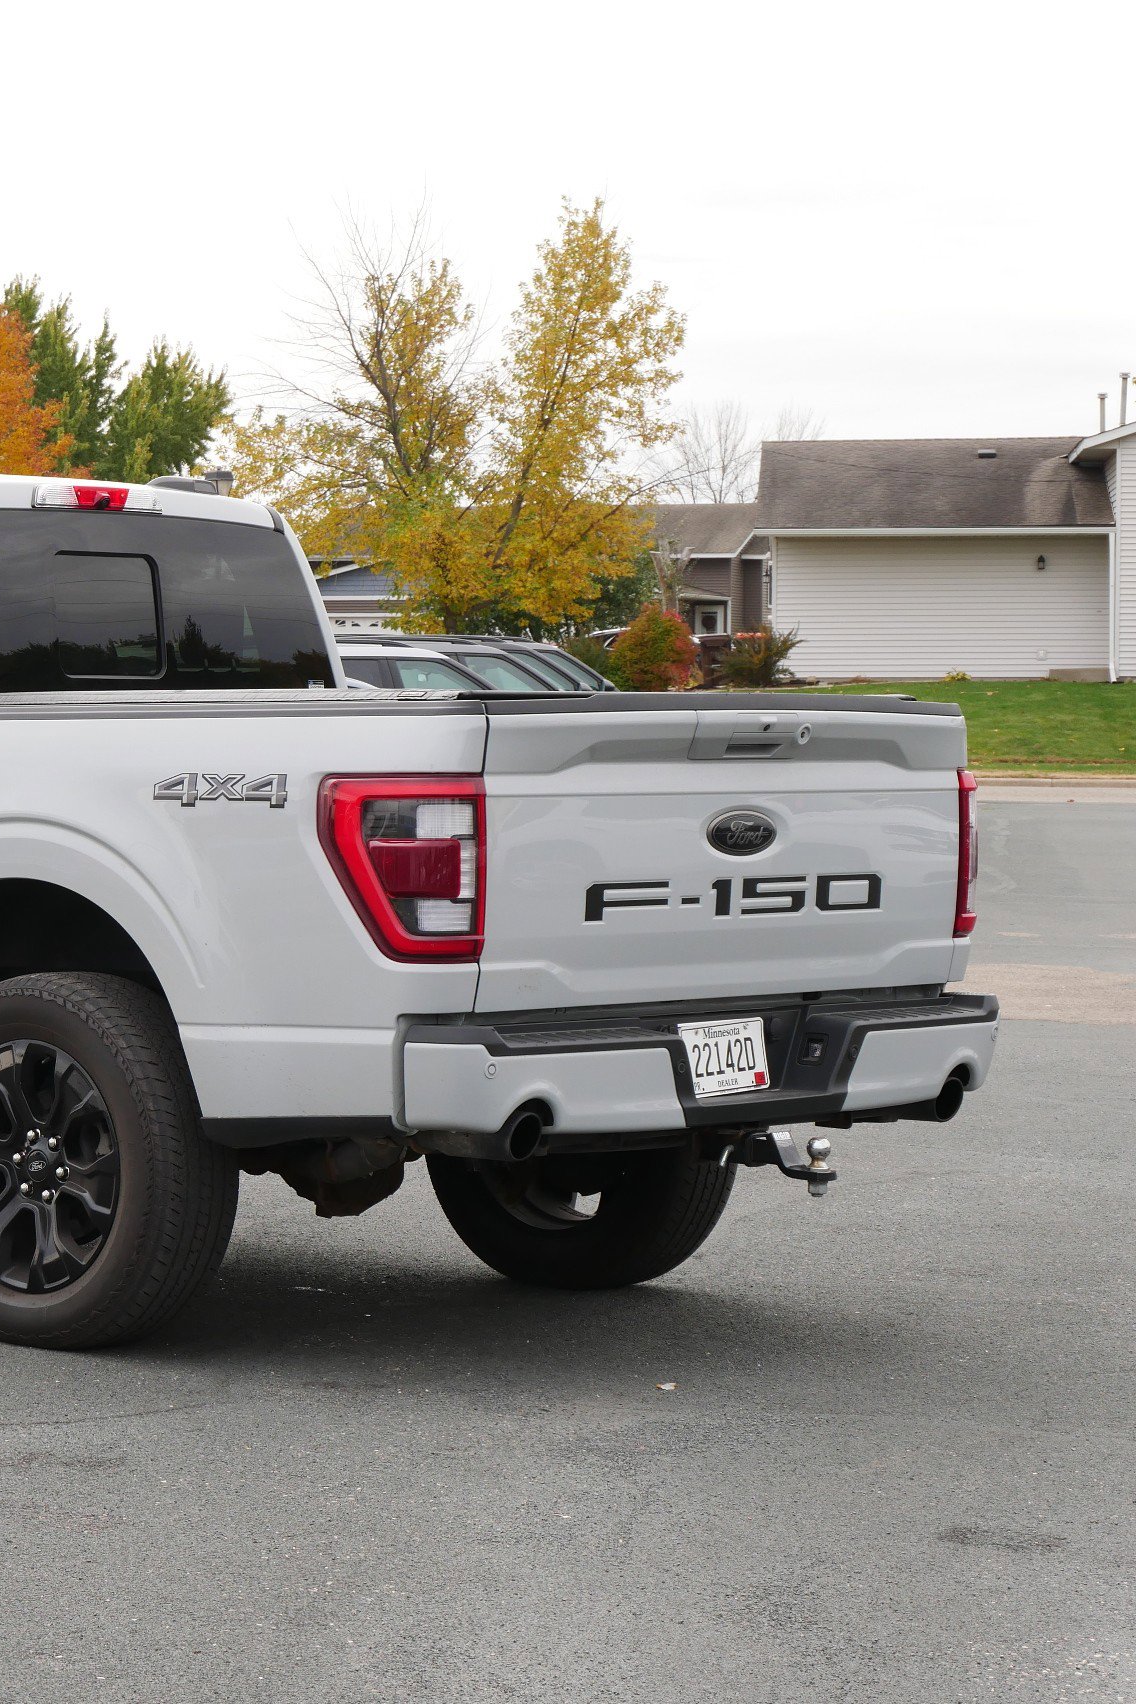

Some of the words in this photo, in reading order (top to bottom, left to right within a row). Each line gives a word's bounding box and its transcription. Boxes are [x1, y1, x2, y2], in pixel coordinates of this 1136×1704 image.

[726, 820, 764, 846] Ford
[584, 873, 882, 922] F-150
[703, 1027, 740, 1040] Minnesota
[692, 1036, 756, 1079] 22142D
[717, 1078, 739, 1088] DEALER
